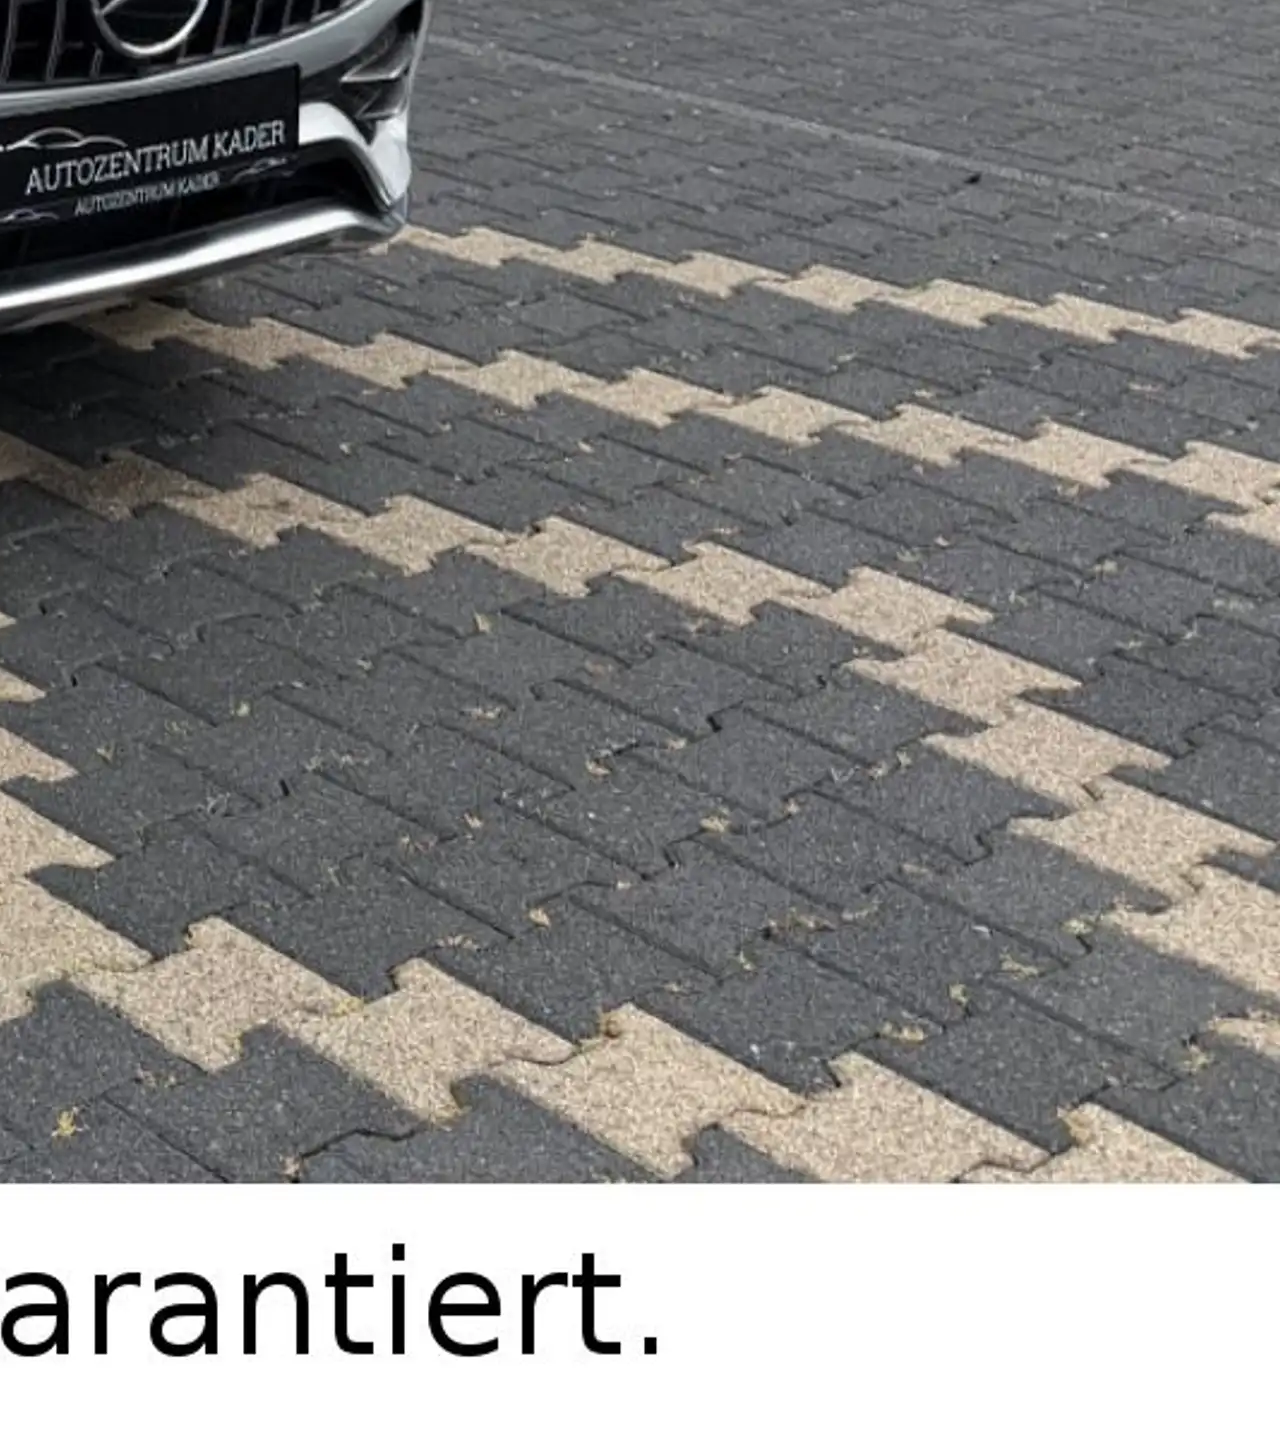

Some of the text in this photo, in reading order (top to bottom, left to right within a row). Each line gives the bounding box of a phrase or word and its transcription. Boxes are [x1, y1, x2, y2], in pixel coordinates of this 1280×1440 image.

[25, 119, 286, 196] AUTOZENTRUM KADER
[74, 170, 220, 217] AUTOZENTRUM KADER
